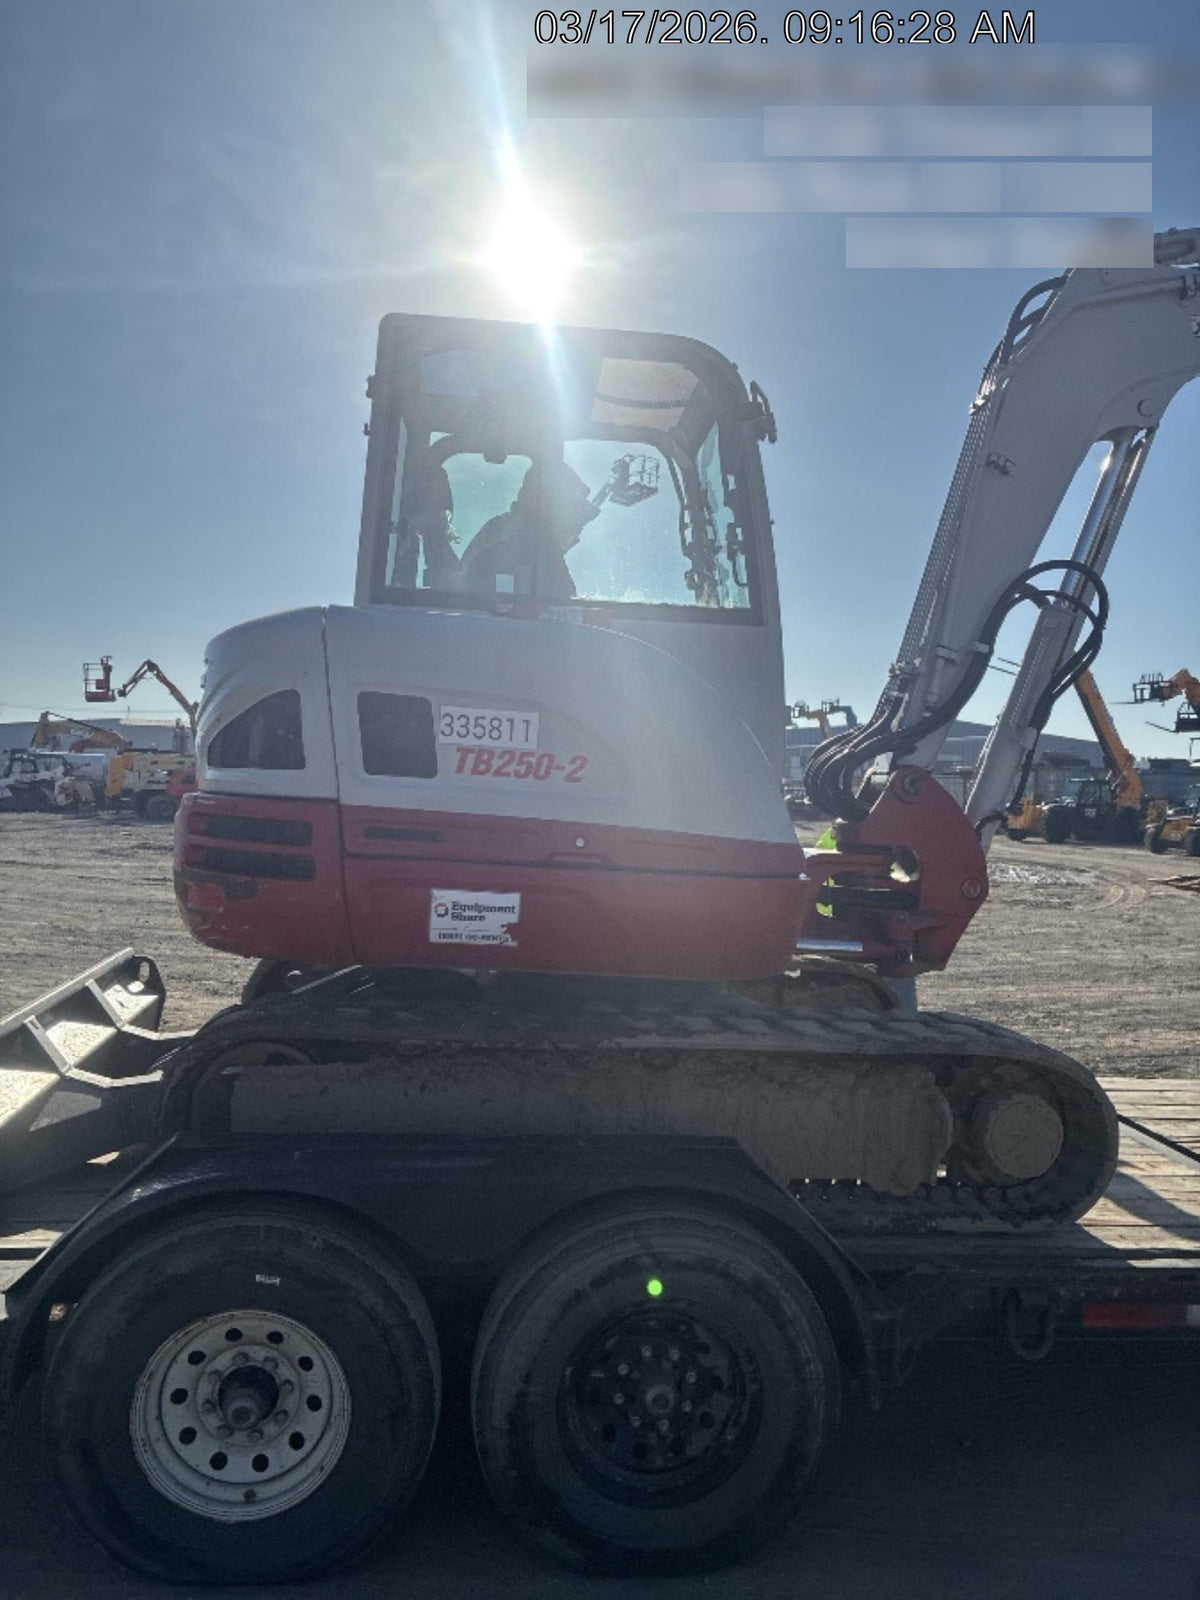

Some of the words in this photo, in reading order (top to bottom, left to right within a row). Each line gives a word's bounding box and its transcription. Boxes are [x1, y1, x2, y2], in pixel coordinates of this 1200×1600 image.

[440, 712, 531, 743] 335811
[454, 747, 590, 783] TB250-2
[452, 901, 517, 914] Equipment
